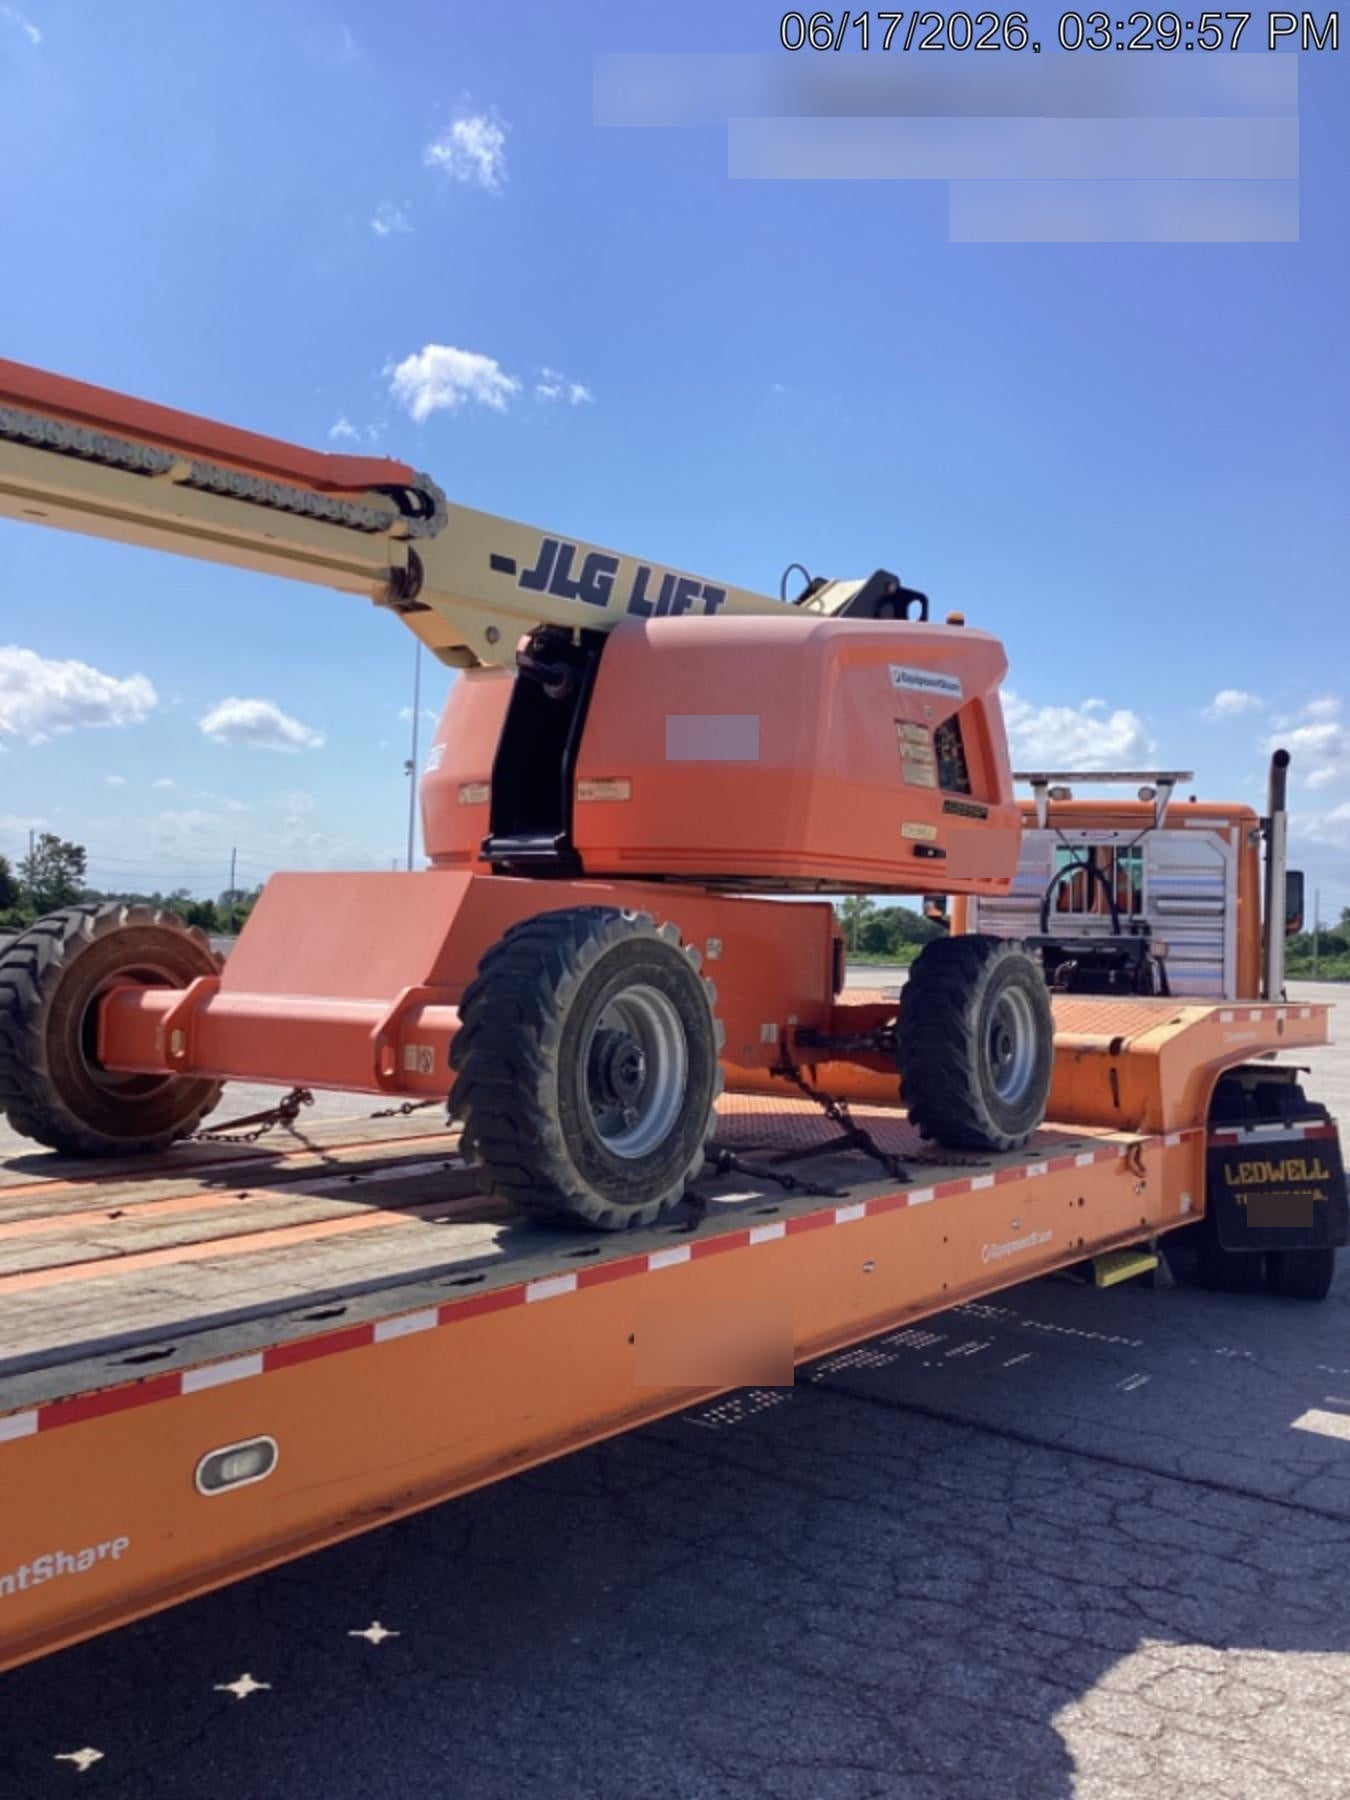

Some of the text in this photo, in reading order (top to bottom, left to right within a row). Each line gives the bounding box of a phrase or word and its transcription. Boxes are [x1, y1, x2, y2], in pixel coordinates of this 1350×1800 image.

[517, 536, 727, 617] JLG LIFT
[1223, 1157, 1331, 1186] LEDWELL
